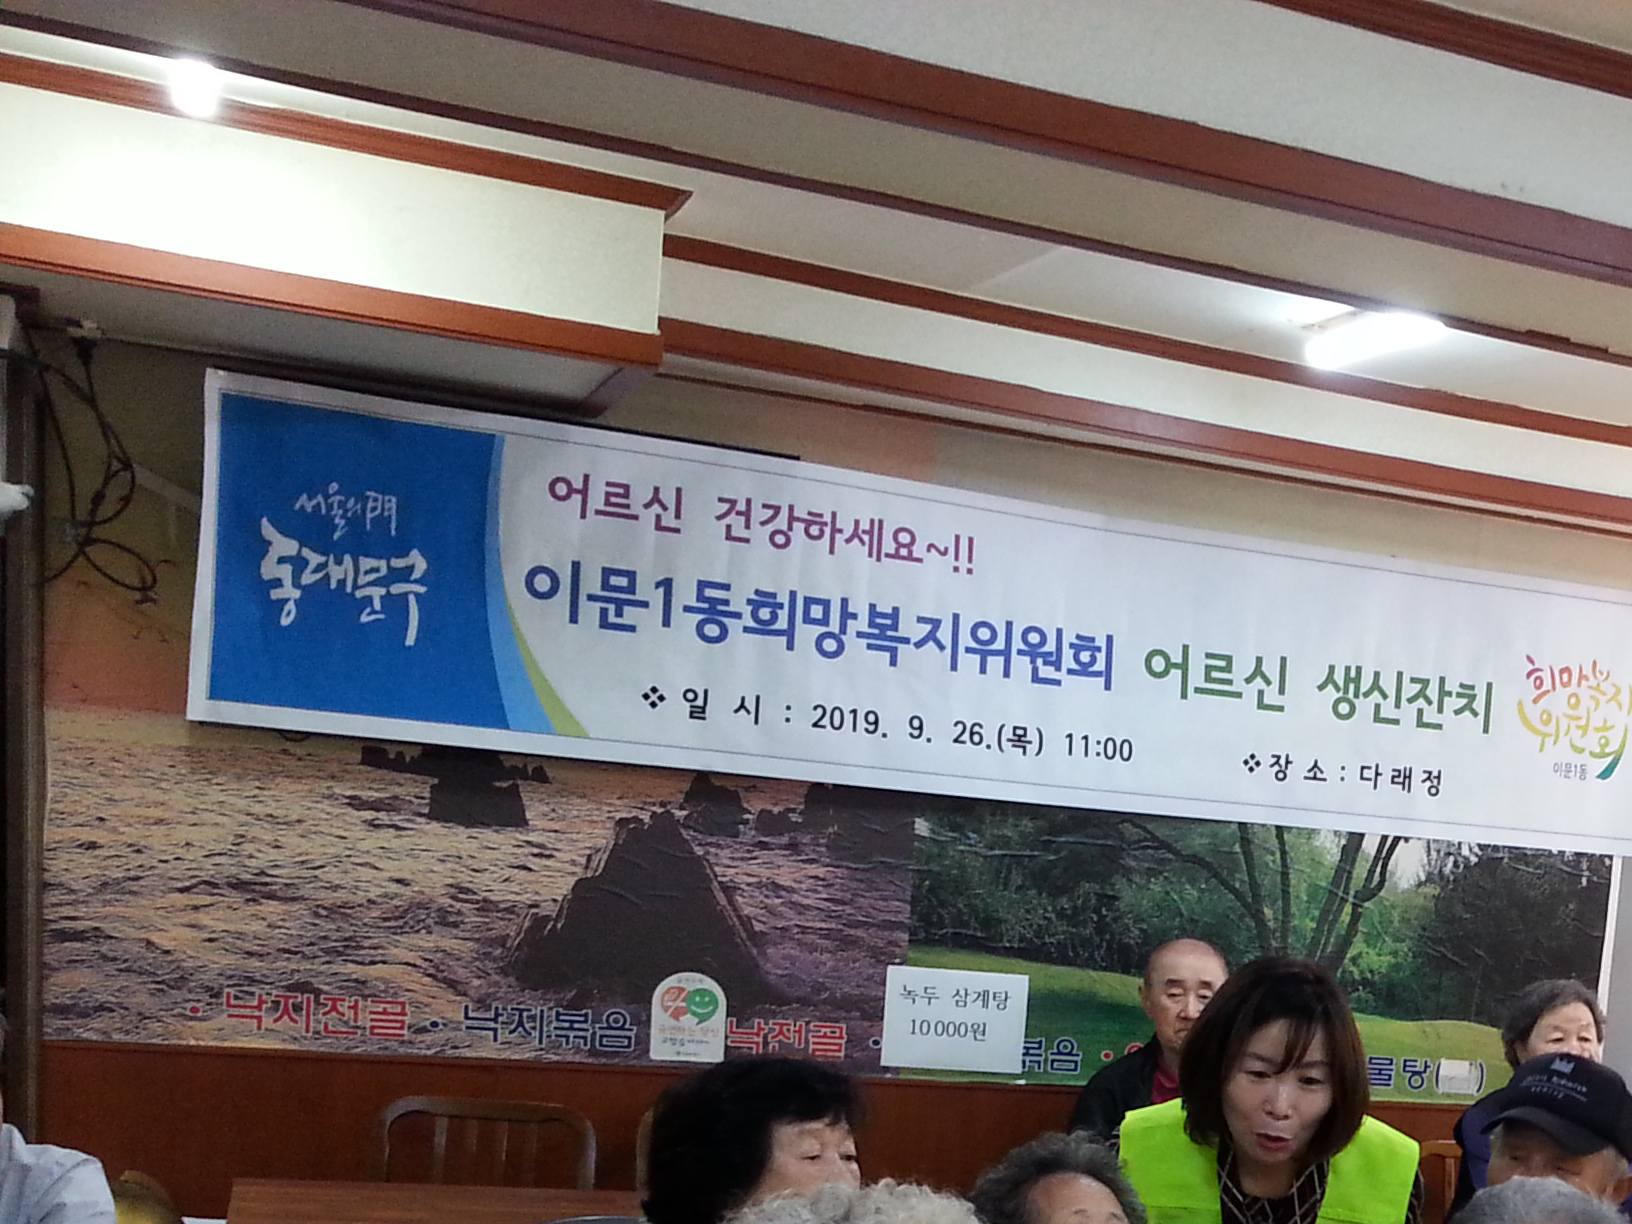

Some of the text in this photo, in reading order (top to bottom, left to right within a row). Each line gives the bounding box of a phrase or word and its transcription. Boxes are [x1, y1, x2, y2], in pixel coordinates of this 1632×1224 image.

[548, 473, 975, 575] 어르신 건강하세요~!!
[260, 516, 428, 647] 동대문구
[524, 560, 1494, 734] 이문1동희망복지위원회 어르신 생신잔치
[811, 704, 889, 739] 2019.
[907, 715, 933, 744] 9.
[952, 720, 1044, 757] 26.(목)
[1065, 732, 1134, 763] 11:00
[223, 989, 411, 1039] 낙지전골
[462, 1002, 637, 1052] 낙지볶음
[899, 984, 1012, 1012] 녹두 삼계탕
